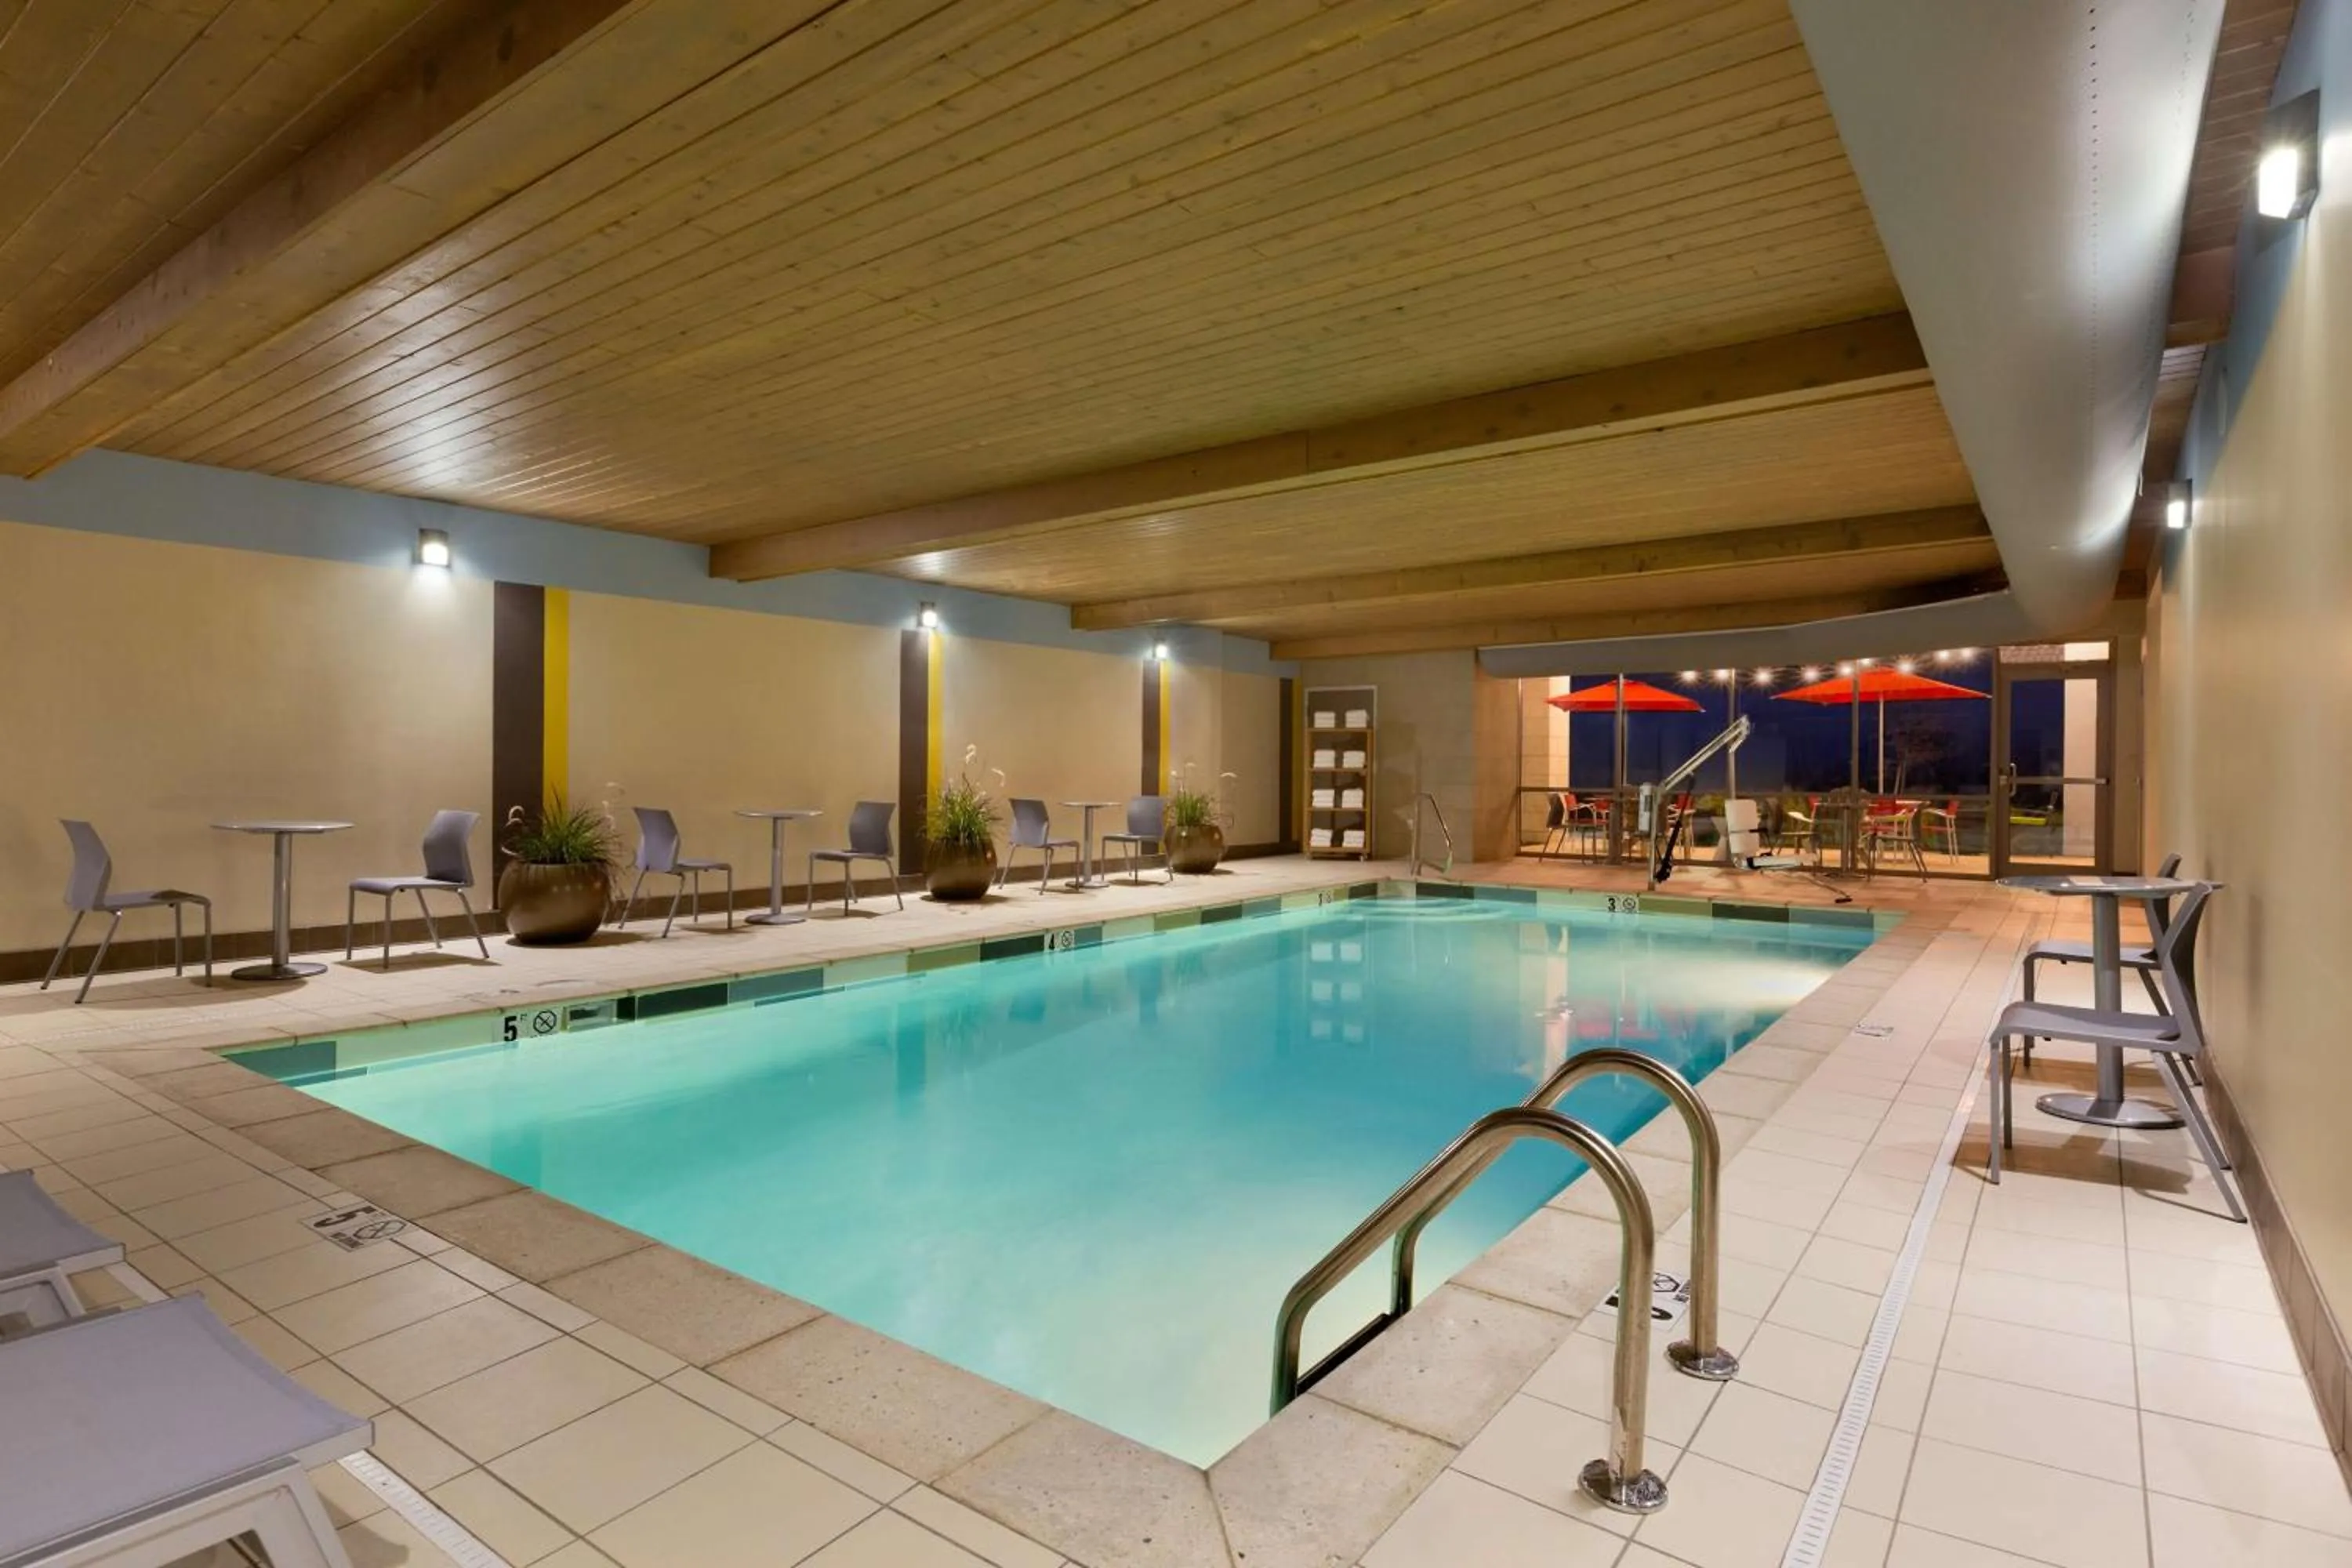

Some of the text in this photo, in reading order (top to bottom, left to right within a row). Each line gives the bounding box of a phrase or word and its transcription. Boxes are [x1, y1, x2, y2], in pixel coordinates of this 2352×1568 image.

[1608, 898, 1616, 913] 3
[504, 1015, 517, 1042] 5
[314, 1206, 377, 1229] 5
